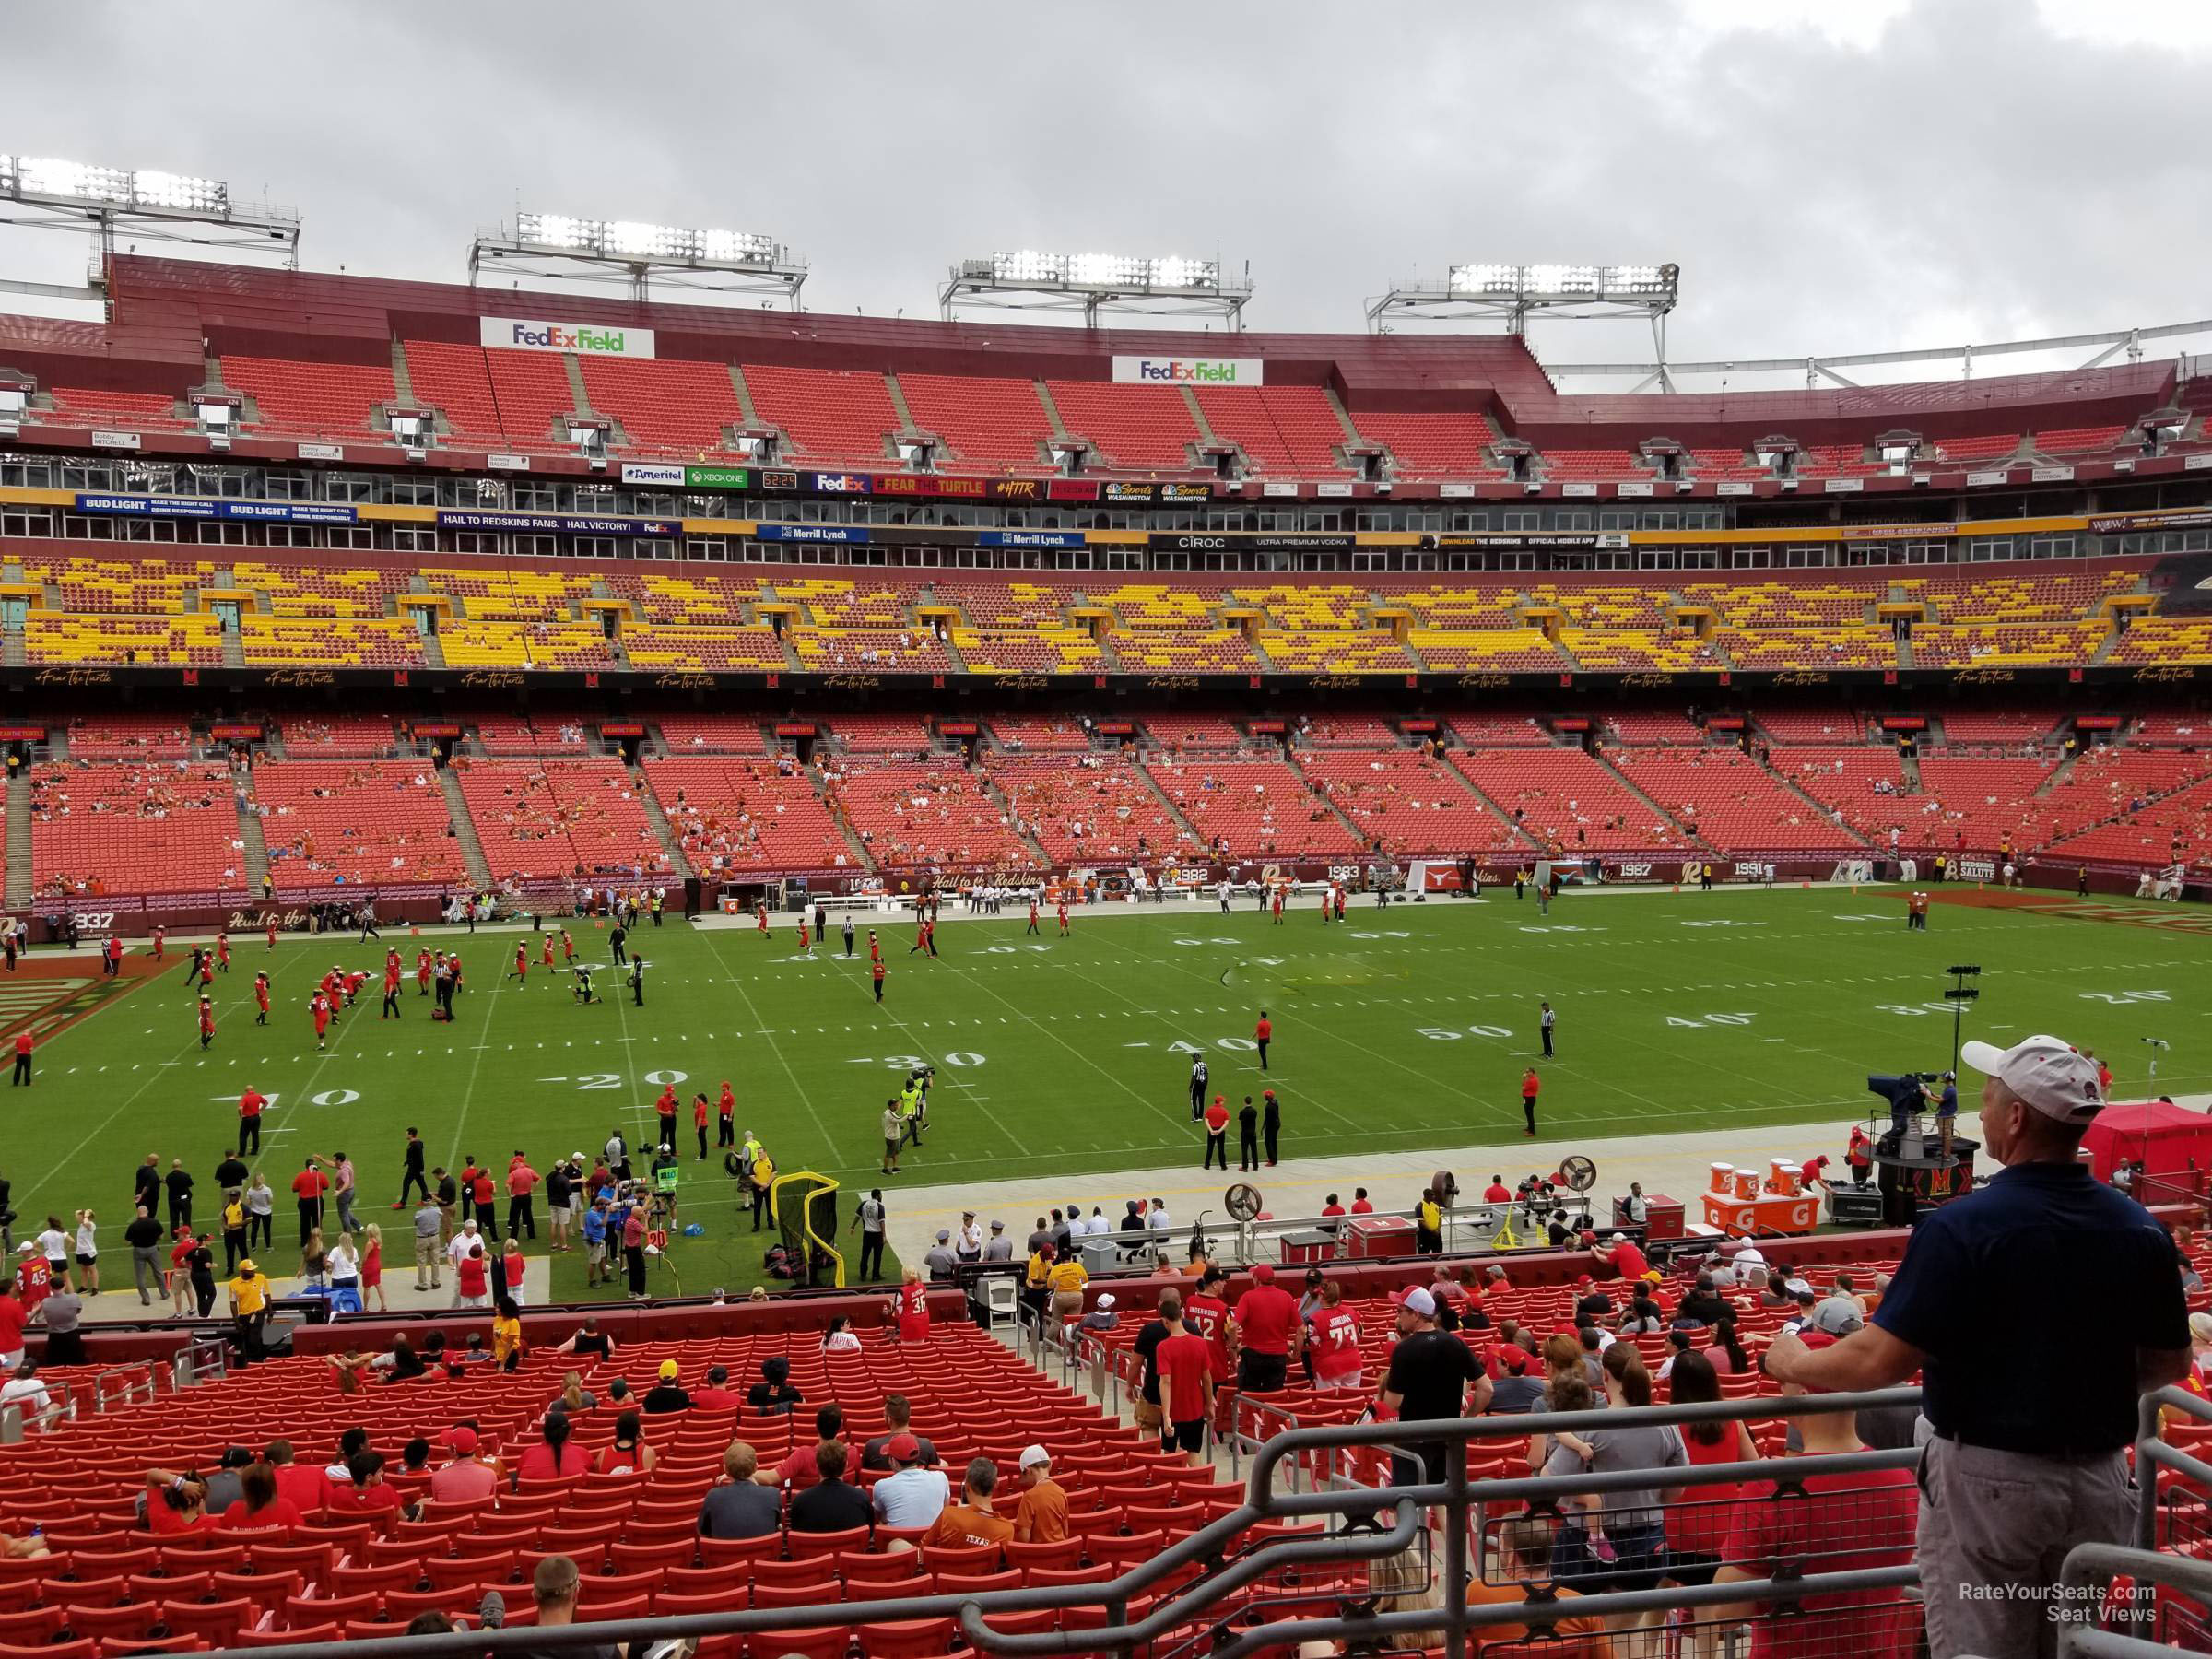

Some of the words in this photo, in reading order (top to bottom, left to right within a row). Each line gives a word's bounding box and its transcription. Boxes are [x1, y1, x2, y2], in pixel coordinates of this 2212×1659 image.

[513, 324, 624, 352] FedExField
[1141, 360, 1235, 381] FedExField
[634, 469, 681, 480] Ameritel
[725, 474, 743, 482] ONE
[818, 474, 865, 491] FedEx
[1121, 483, 1154, 495] Sports
[1177, 484, 1210, 496] Sports
[86, 499, 110, 508] BUD
[112, 500, 146, 510] LIGHT
[230, 505, 253, 514] BUD
[255, 506, 288, 516] LIGHT
[443, 514, 465, 524] HAIL
[466, 515, 480, 524] TO
[482, 517, 530, 527] REDSKINS
[532, 519, 559, 528] FANS.
[567, 521, 588, 530] HAIL
[793, 528, 821, 539] Merrill
[822, 530, 847, 541] Lynch
[1013, 534, 1039, 545] Merrill
[1041, 535, 1065, 546] Lynch
[1256, 538, 1280, 547] ULTRA
[1282, 538, 1319, 547] PREMIUM
[1321, 538, 1347, 547] VODKA
[1620, 864, 1652, 877] 1987
[1735, 863, 1762, 875] 1991
[1960, 867, 1994, 878] SALUTE
[932, 875, 959, 888] Hail
[959, 876, 971, 886] to
[75, 913, 114, 929] 937
[1665, 1014, 1750, 1028] 40
[1415, 1024, 1513, 1041] 50
[1166, 1037, 1259, 1053] 40
[884, 1052, 986, 1070] 30
[576, 1069, 688, 1090] 20
[1747, 1180, 1757, 1190] G
[1792, 1176, 1801, 1186] G
[1710, 1209, 1719, 1224] G
[1736, 1207, 1755, 1228] G
[1792, 1203, 1809, 1226] G
[649, 1230, 665, 1248] 20
[32, 1268, 48, 1286] 45
[1329, 1312, 1353, 1328] JORDAN
[829, 1335, 854, 1348] RAPINS
[965, 1534, 994, 1547] TEXAS
